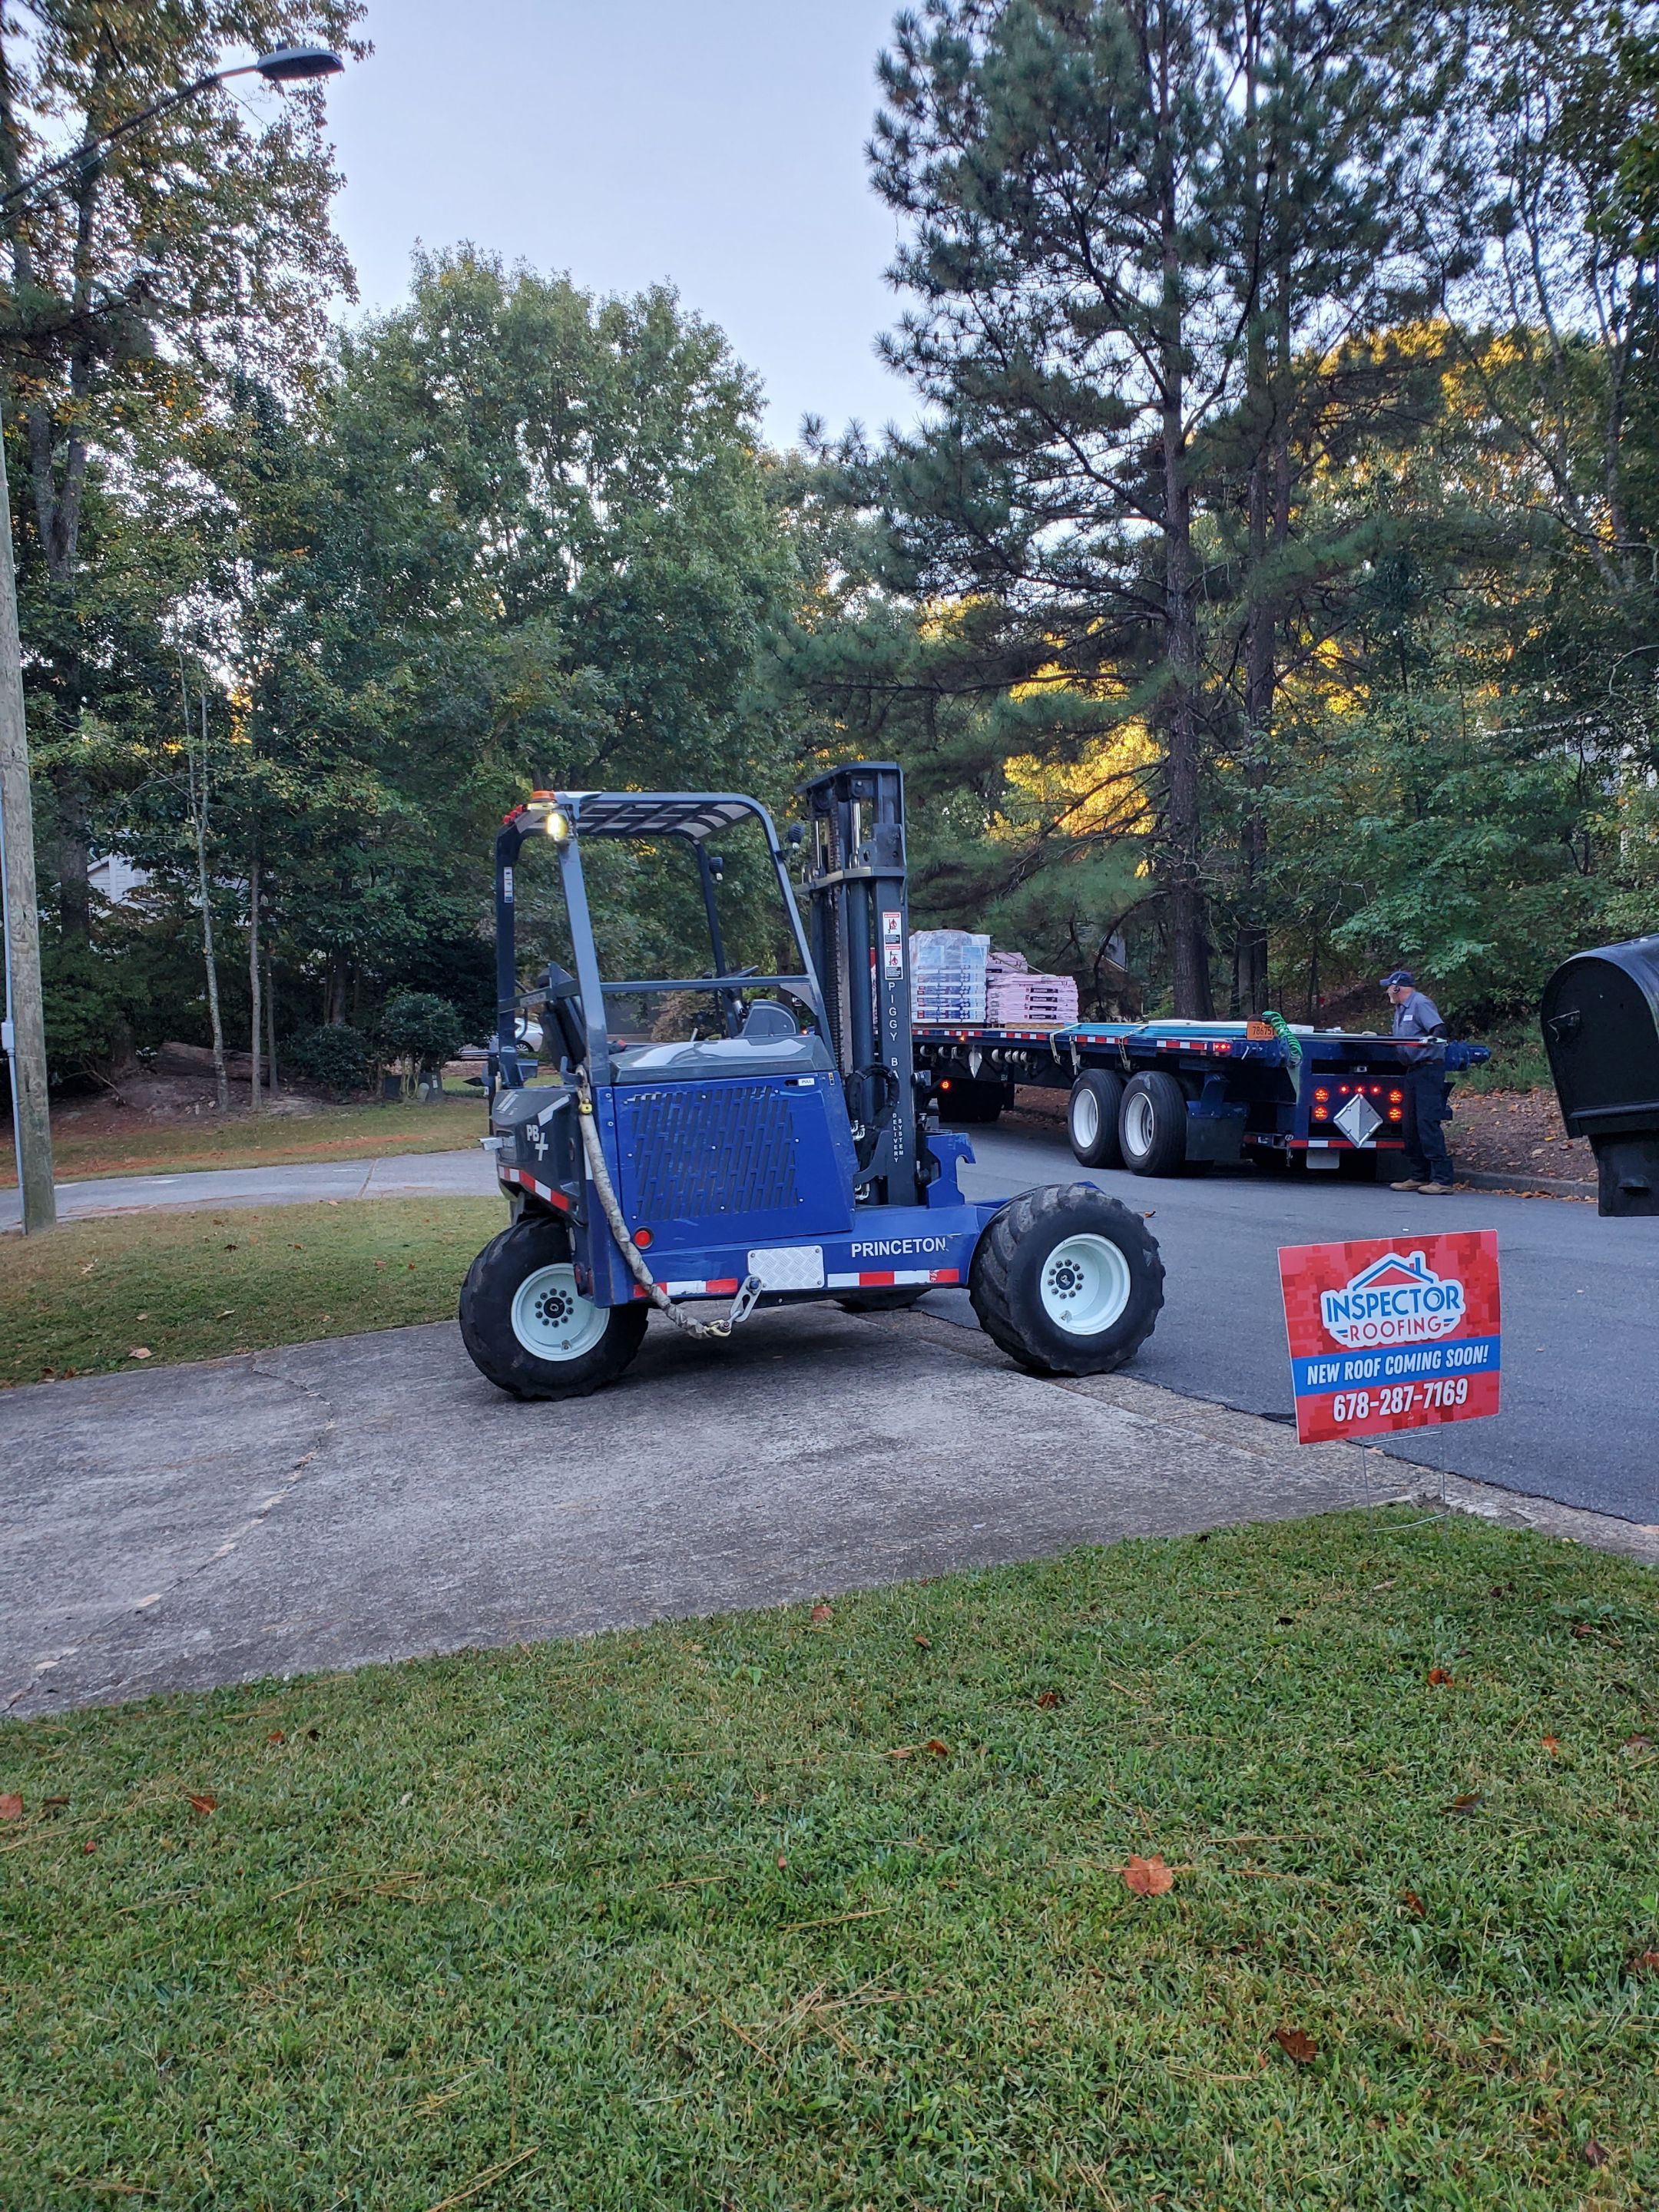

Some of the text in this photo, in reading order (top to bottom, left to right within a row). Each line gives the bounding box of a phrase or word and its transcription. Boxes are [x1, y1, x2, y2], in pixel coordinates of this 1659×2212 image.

[888, 982, 898, 1041] PIGGY
[851, 1237, 946, 1258] PRINCETON
[1326, 1286, 1461, 1323] INSPECTOR
[1350, 1316, 1442, 1342] ROOFING
[1306, 1345, 1489, 1386] NEW ROOF COMING SOON!
[1333, 1379, 1468, 1422] 678-287-7169
